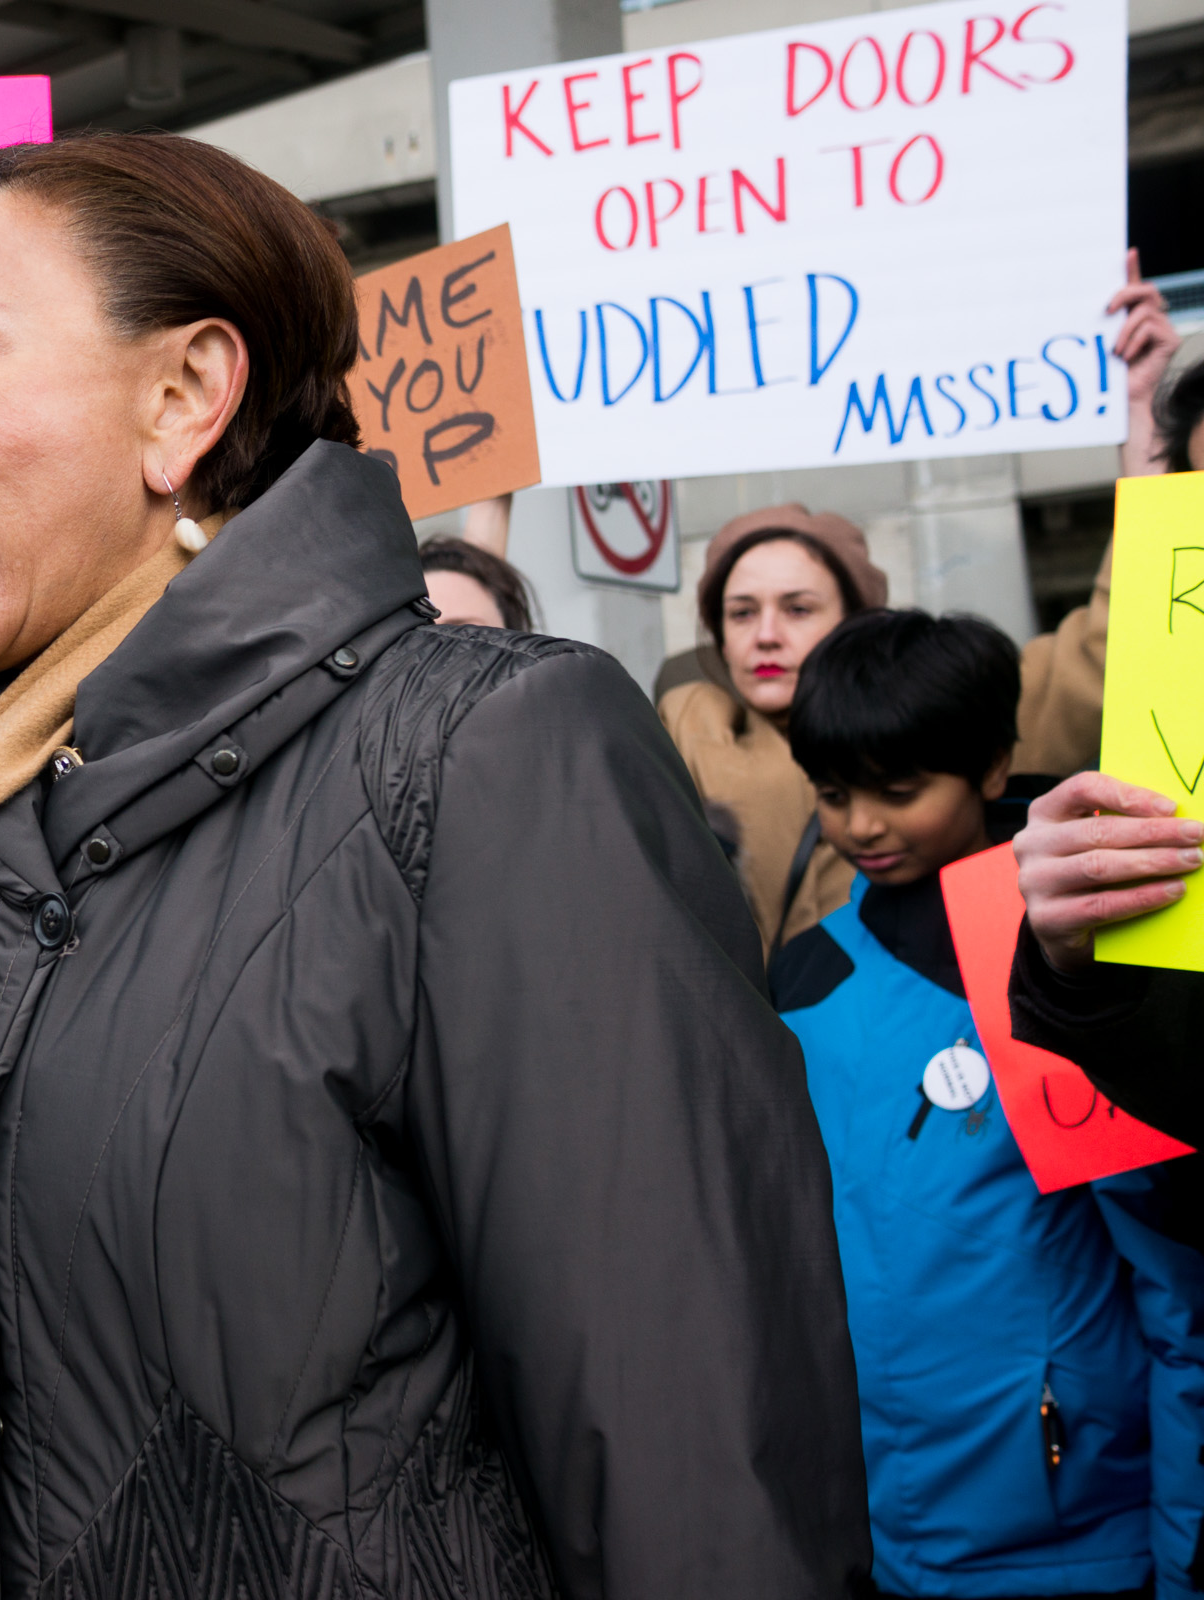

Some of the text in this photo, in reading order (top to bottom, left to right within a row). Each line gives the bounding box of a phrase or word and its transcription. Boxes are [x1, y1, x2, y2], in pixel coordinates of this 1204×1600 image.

[502, 3, 1075, 158] KEEP DOORS
[595, 133, 944, 251] OPEN TO
[358, 250, 496, 362] ME
[520, 273, 860, 407] UDDLED
[366, 334, 486, 432] YOU
[833, 333, 1109, 455] MASSES!
